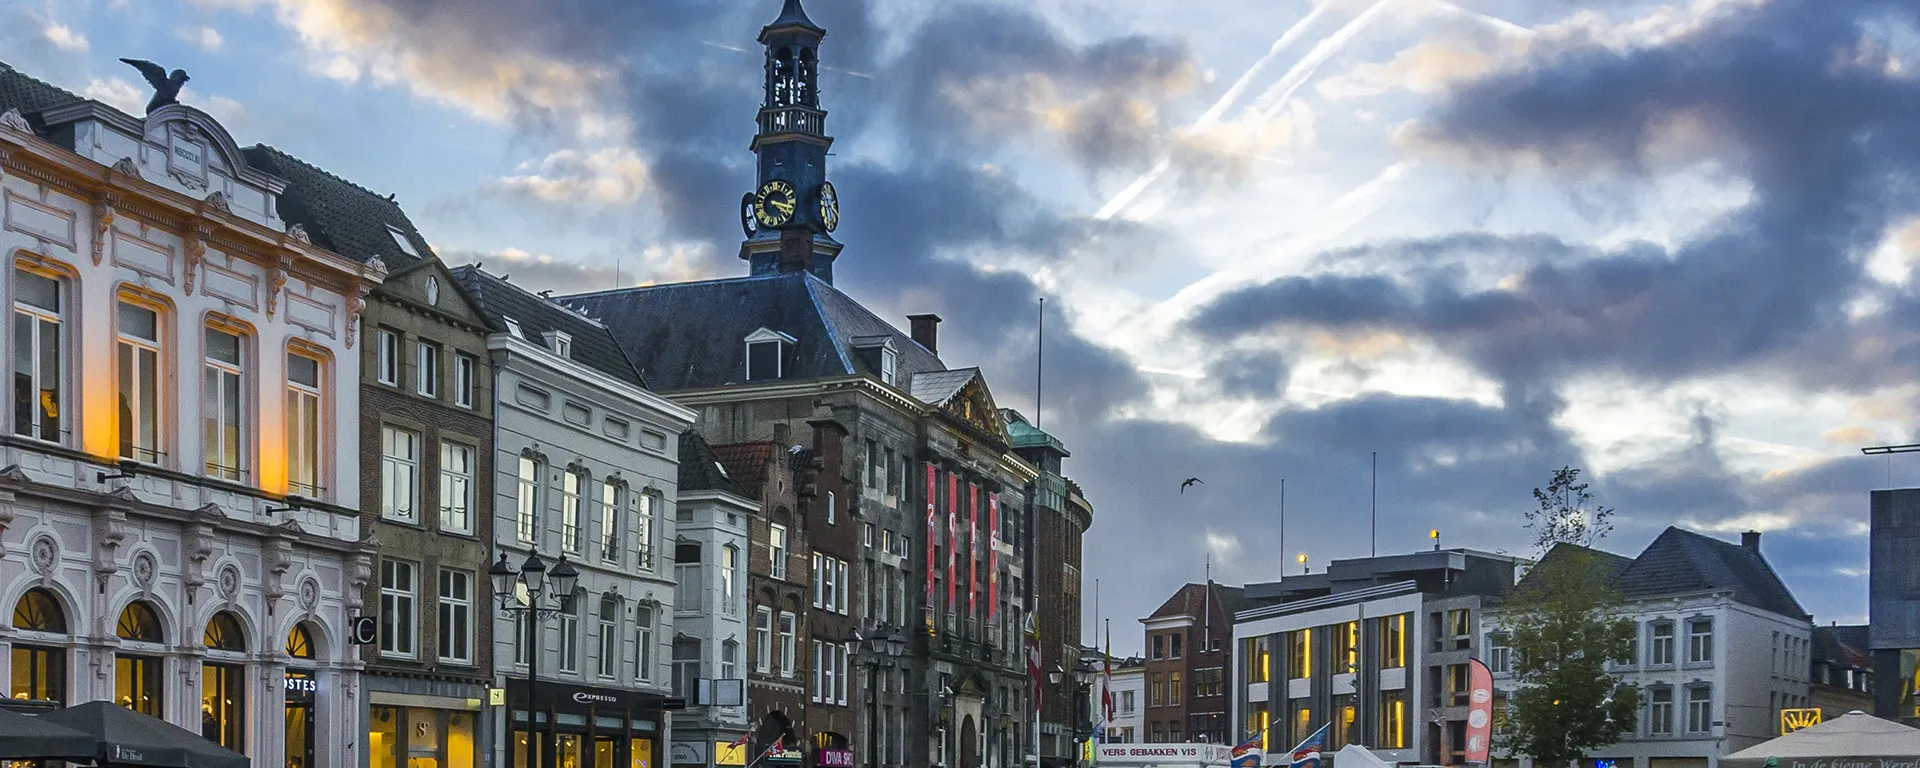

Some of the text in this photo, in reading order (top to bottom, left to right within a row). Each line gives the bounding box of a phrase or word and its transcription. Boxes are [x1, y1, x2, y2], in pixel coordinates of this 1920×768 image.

[357, 618, 374, 643] C
[825, 751, 843, 765] DIVA
[1102, 748, 1197, 757] VERS GEBAKKEN VIS
